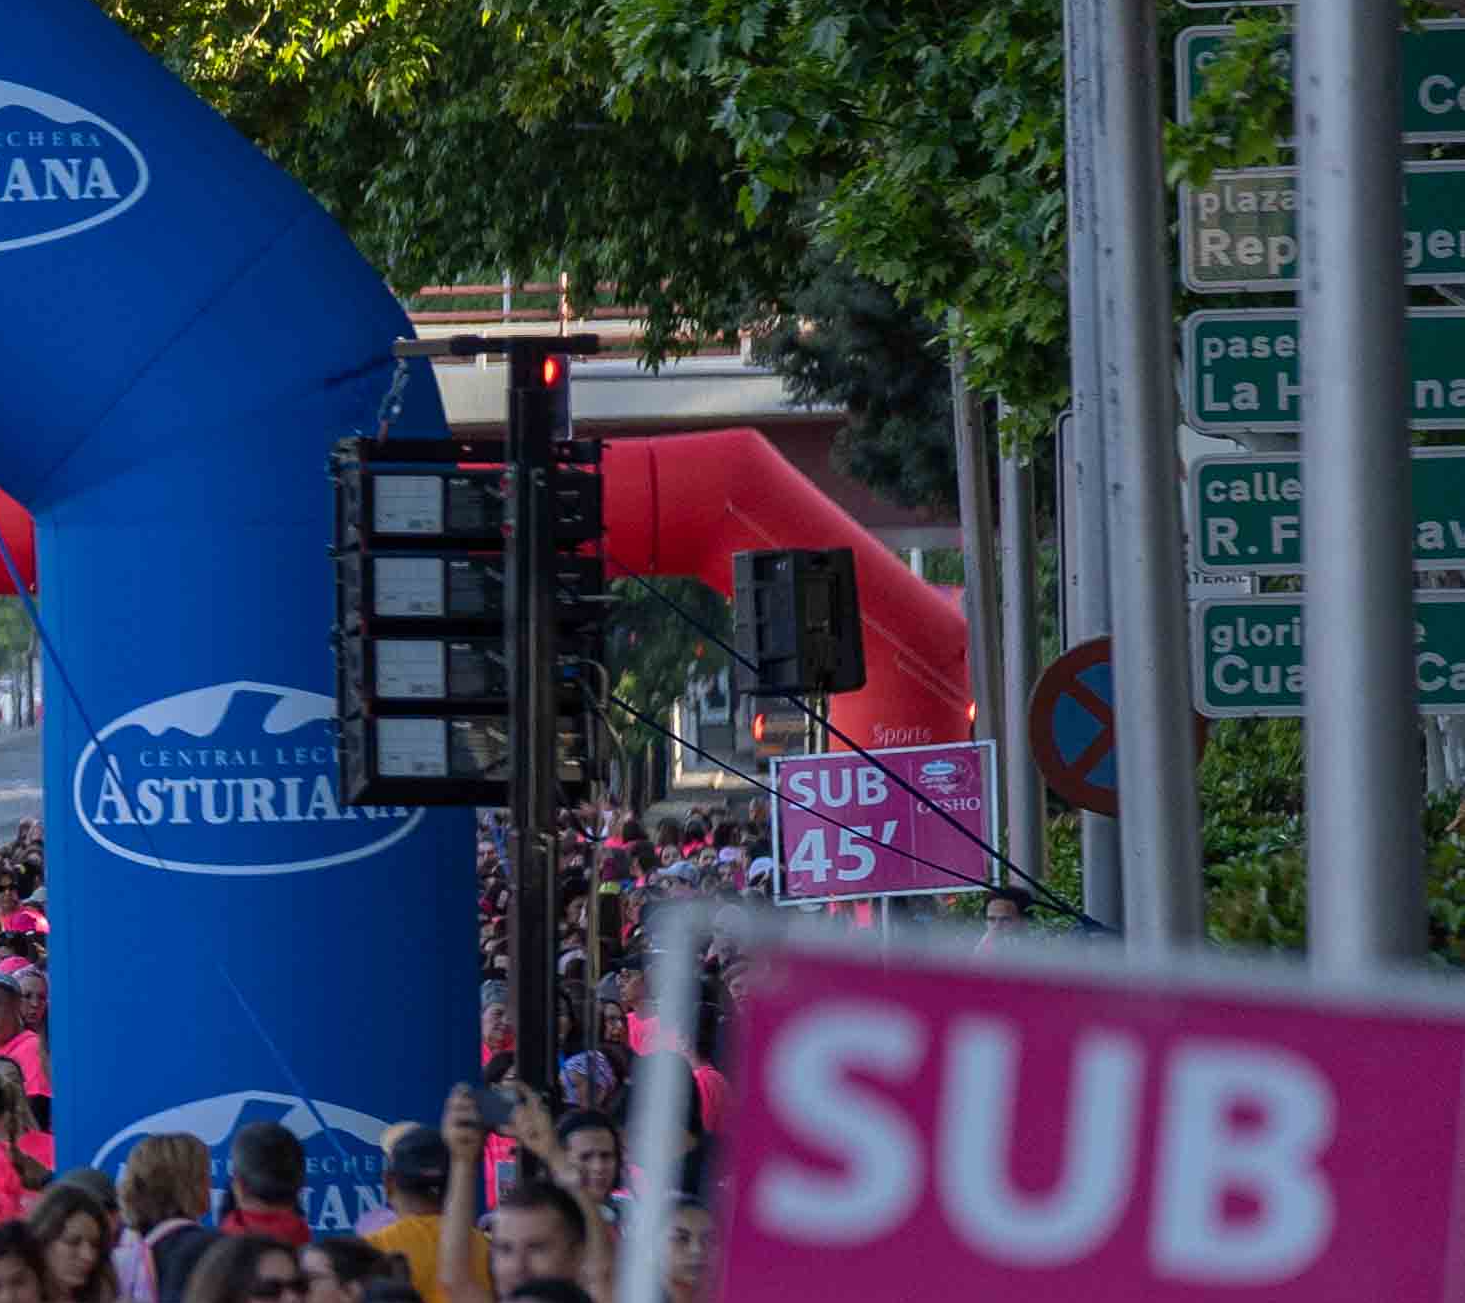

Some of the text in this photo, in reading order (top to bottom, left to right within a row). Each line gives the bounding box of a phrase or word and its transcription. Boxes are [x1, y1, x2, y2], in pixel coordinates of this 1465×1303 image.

[1199, 229, 1301, 275] Rep
[1203, 335, 1302, 365] pase
[1204, 374, 1260, 412] La
[1206, 472, 1303, 503] calle
[1206, 517, 1258, 556] R.
[1211, 618, 1301, 654] glori
[1211, 655, 1306, 695] Cua
[873, 723, 932, 745] Sports
[140, 744, 339, 768] CENTRAL LEC
[788, 765, 889, 810] SUB
[752, 998, 1338, 1287] SUB
